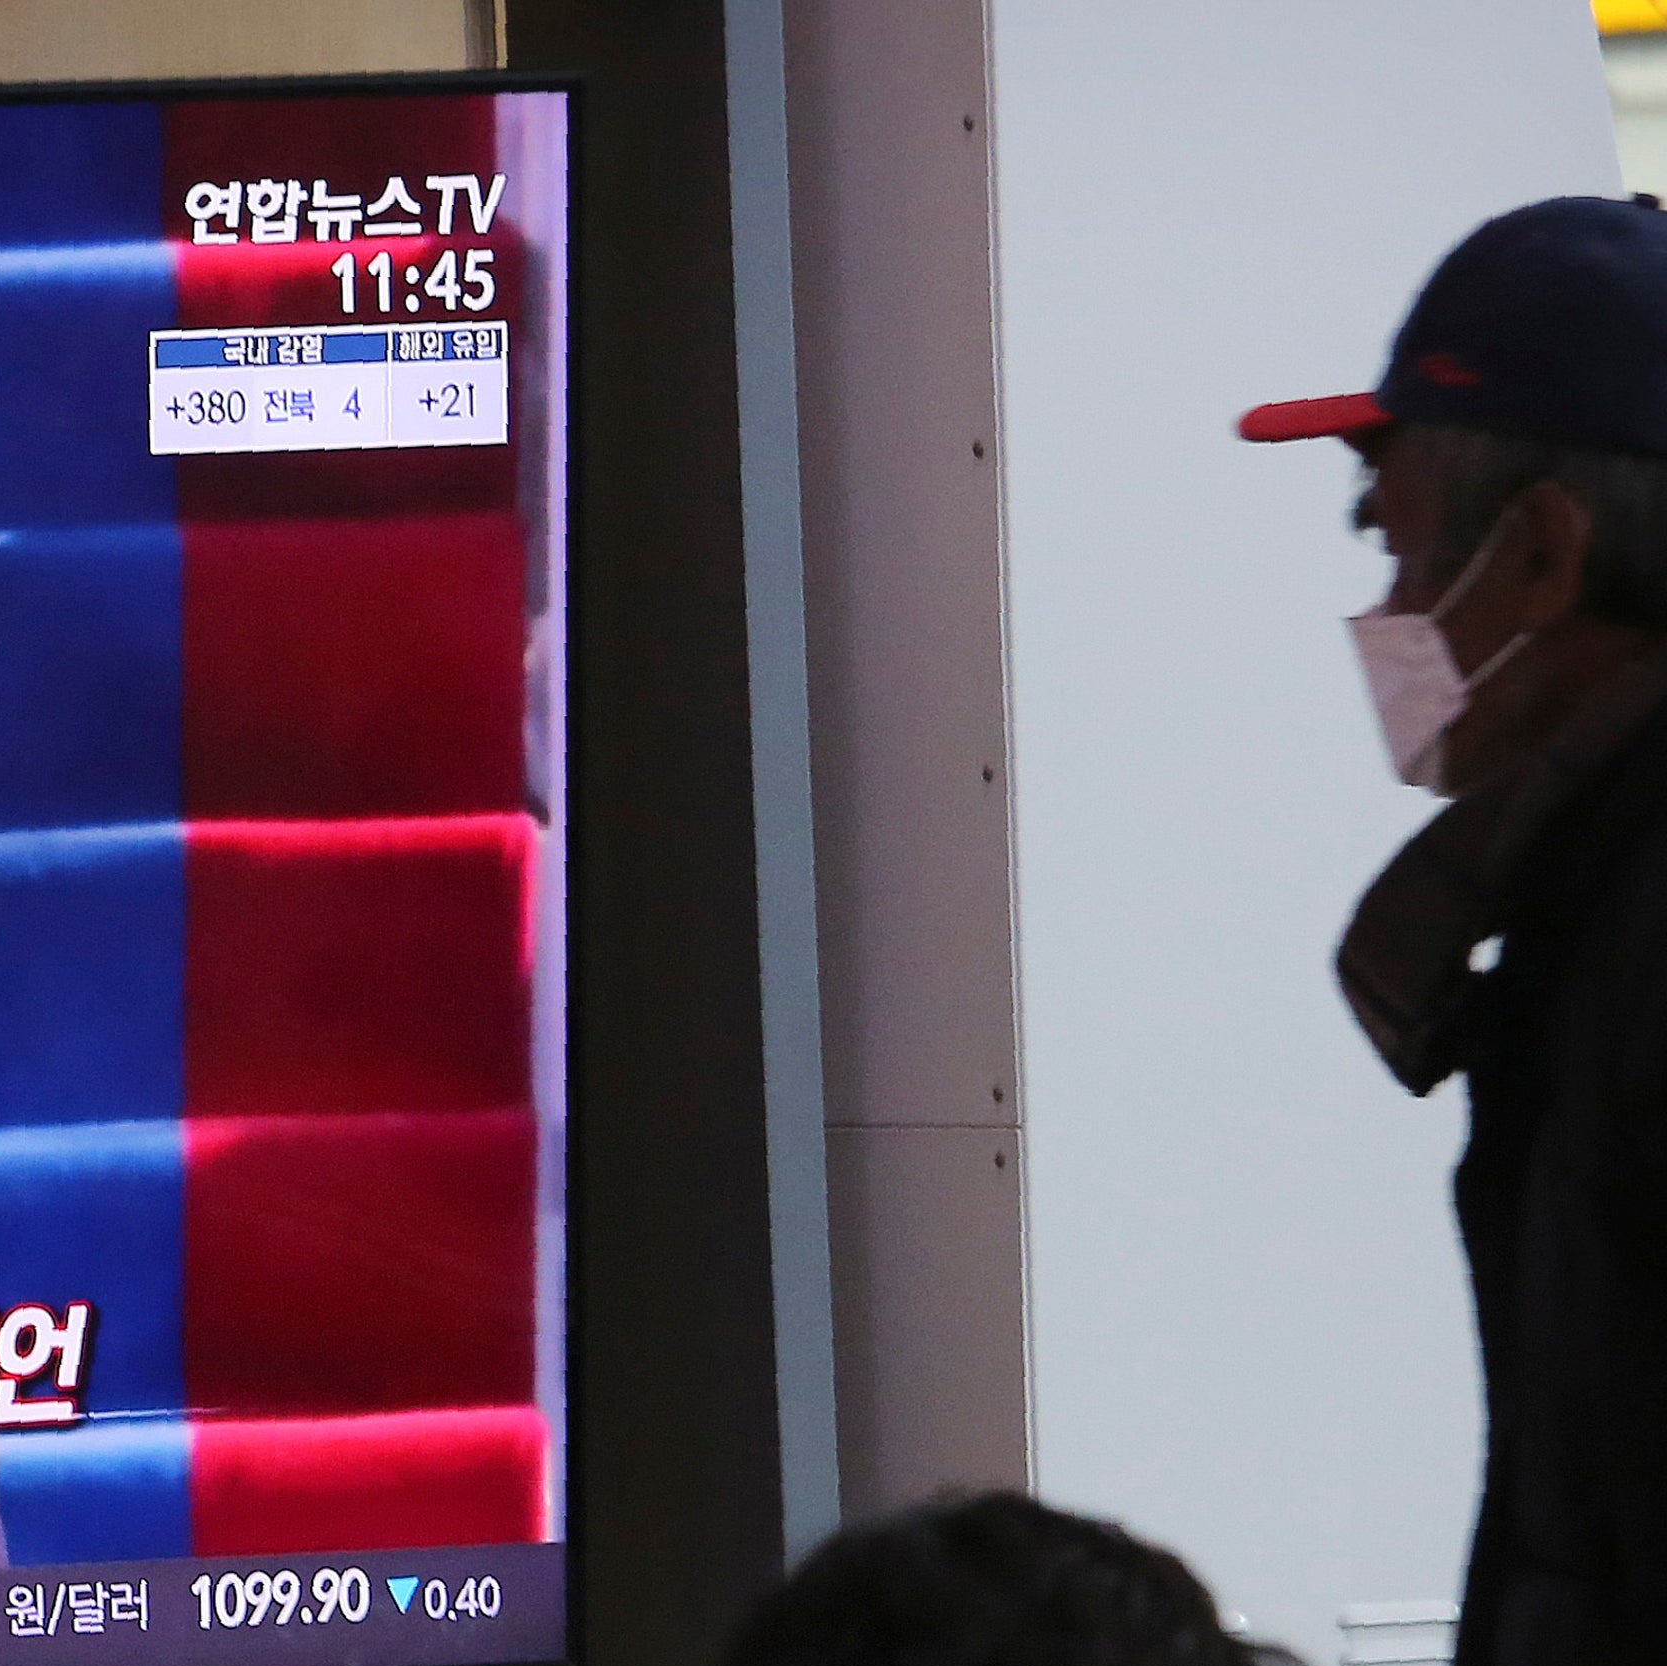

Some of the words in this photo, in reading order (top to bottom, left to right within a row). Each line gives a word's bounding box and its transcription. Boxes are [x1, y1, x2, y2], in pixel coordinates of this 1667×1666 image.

[185, 174, 507, 245] 연합뉴스TV
[330, 248, 496, 314] 11:45
[166, 390, 246, 424] +380
[263, 388, 315, 423] 전북
[343, 386, 362, 420] 4
[419, 382, 475, 417] +21
[5, 1581, 149, 1637] 원/달러
[191, 1568, 370, 1630] 1099.90
[424, 1577, 502, 1622] 0.40
